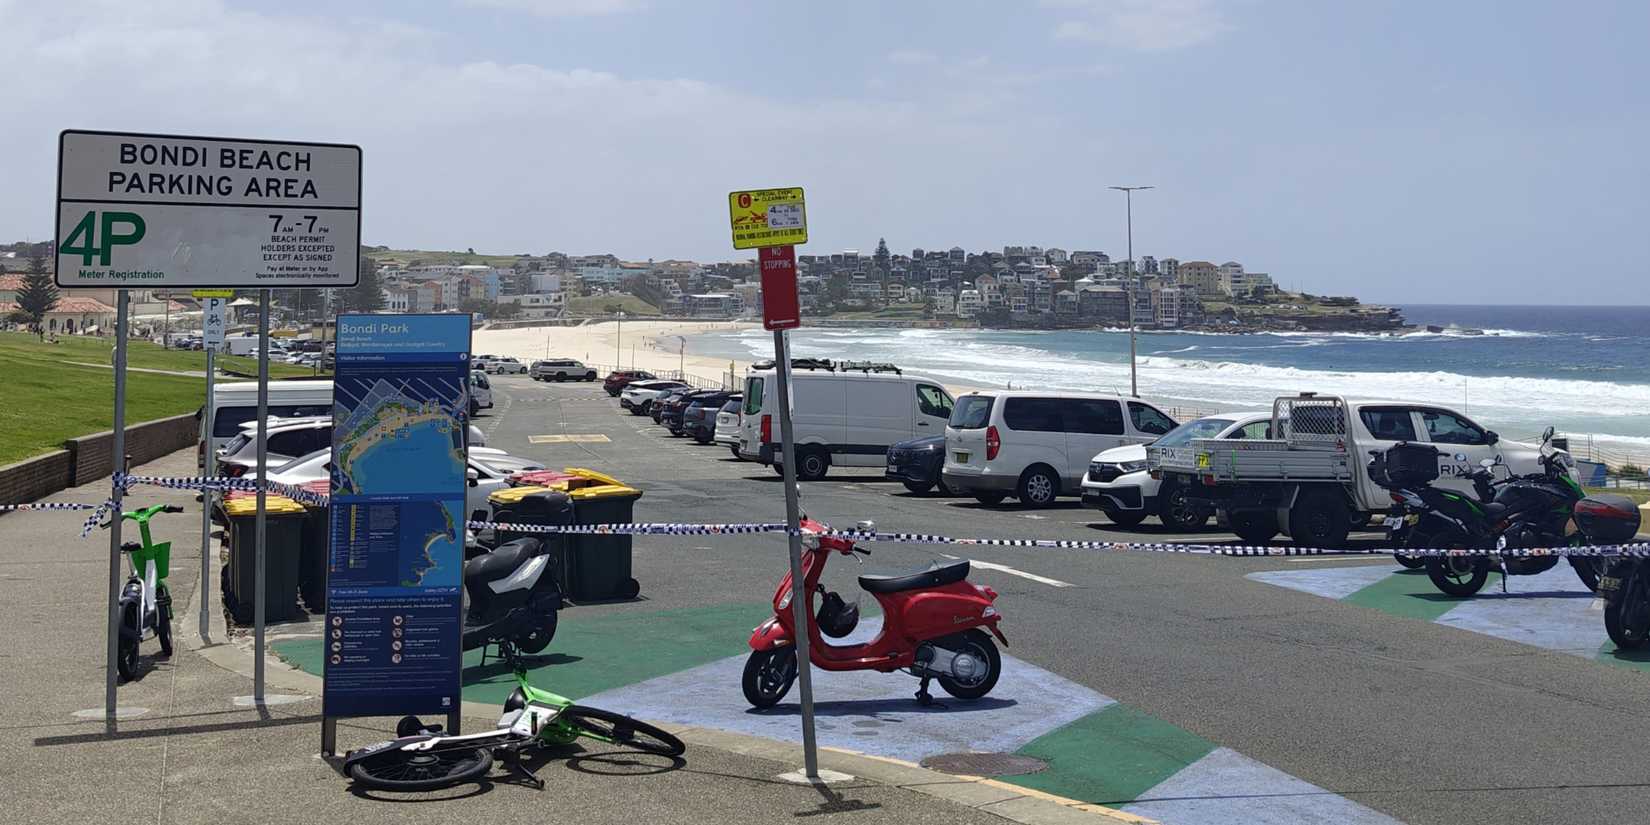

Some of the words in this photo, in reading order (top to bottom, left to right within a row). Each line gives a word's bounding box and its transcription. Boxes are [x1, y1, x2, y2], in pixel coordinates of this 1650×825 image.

[119, 143, 208, 168] BONDI
[219, 149, 311, 171] BEACH
[108, 171, 233, 196] PARKING
[244, 177, 319, 199] AREA
[59, 210, 147, 266] 4P
[271, 235, 297, 243] BEACH
[261, 244, 296, 252] HOLDERS
[771, 246, 782, 256] NO
[763, 259, 792, 270] STOPPING
[78, 269, 105, 279] Meter
[108, 269, 165, 281] Registration
[210, 298, 219, 311] P
[341, 322, 377, 334] Bondi
[381, 322, 409, 334] Park
[1161, 447, 1176, 459] RIX
[1440, 464, 1467, 475] RIX
